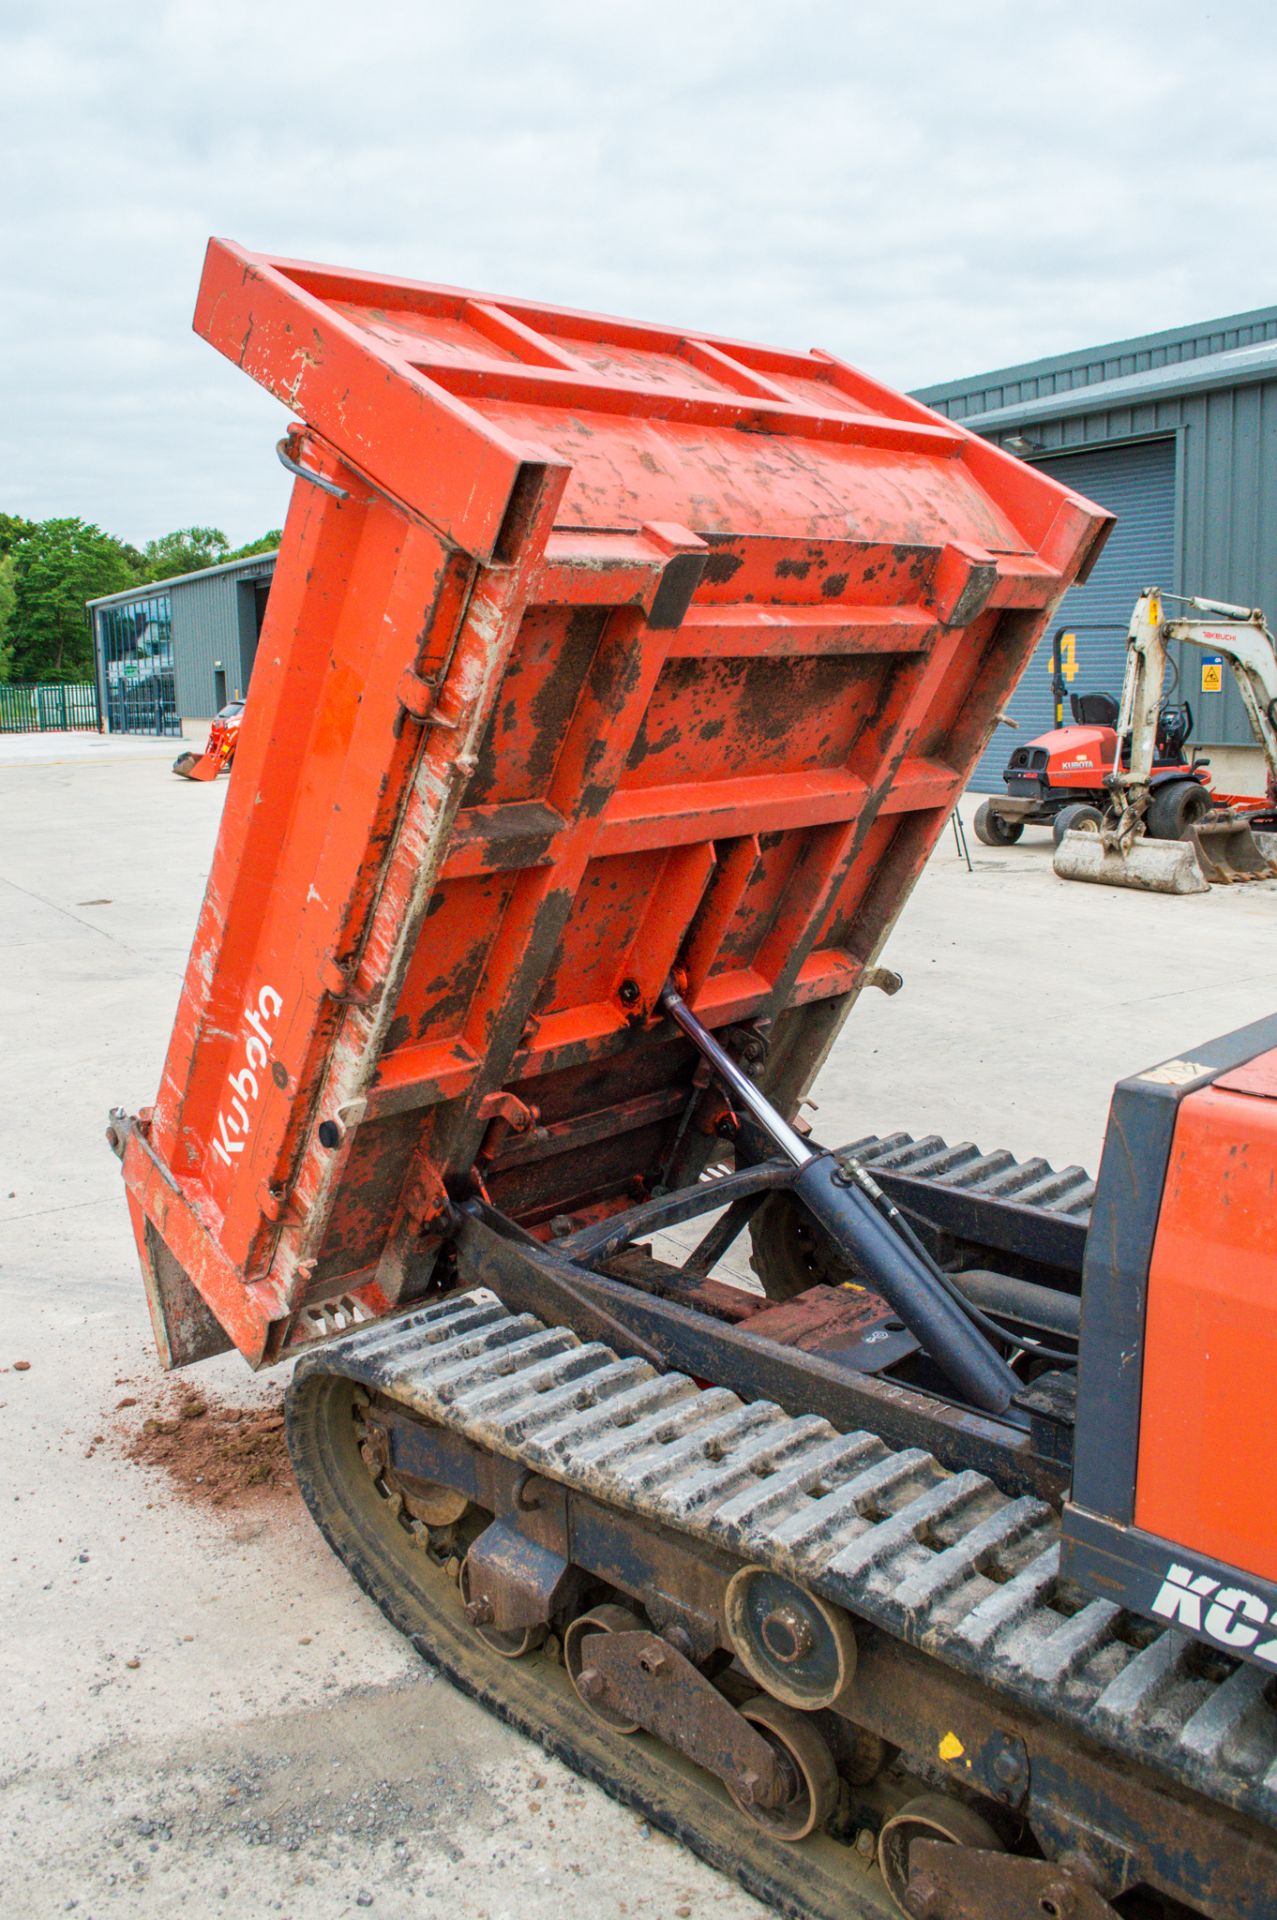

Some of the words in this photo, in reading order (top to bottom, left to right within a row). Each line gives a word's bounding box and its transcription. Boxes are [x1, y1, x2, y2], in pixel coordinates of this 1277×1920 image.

[1203, 631, 1237, 641] TAKEUCHI
[1048, 633, 1079, 682] 4
[1062, 760, 1094, 770] KUBOTA
